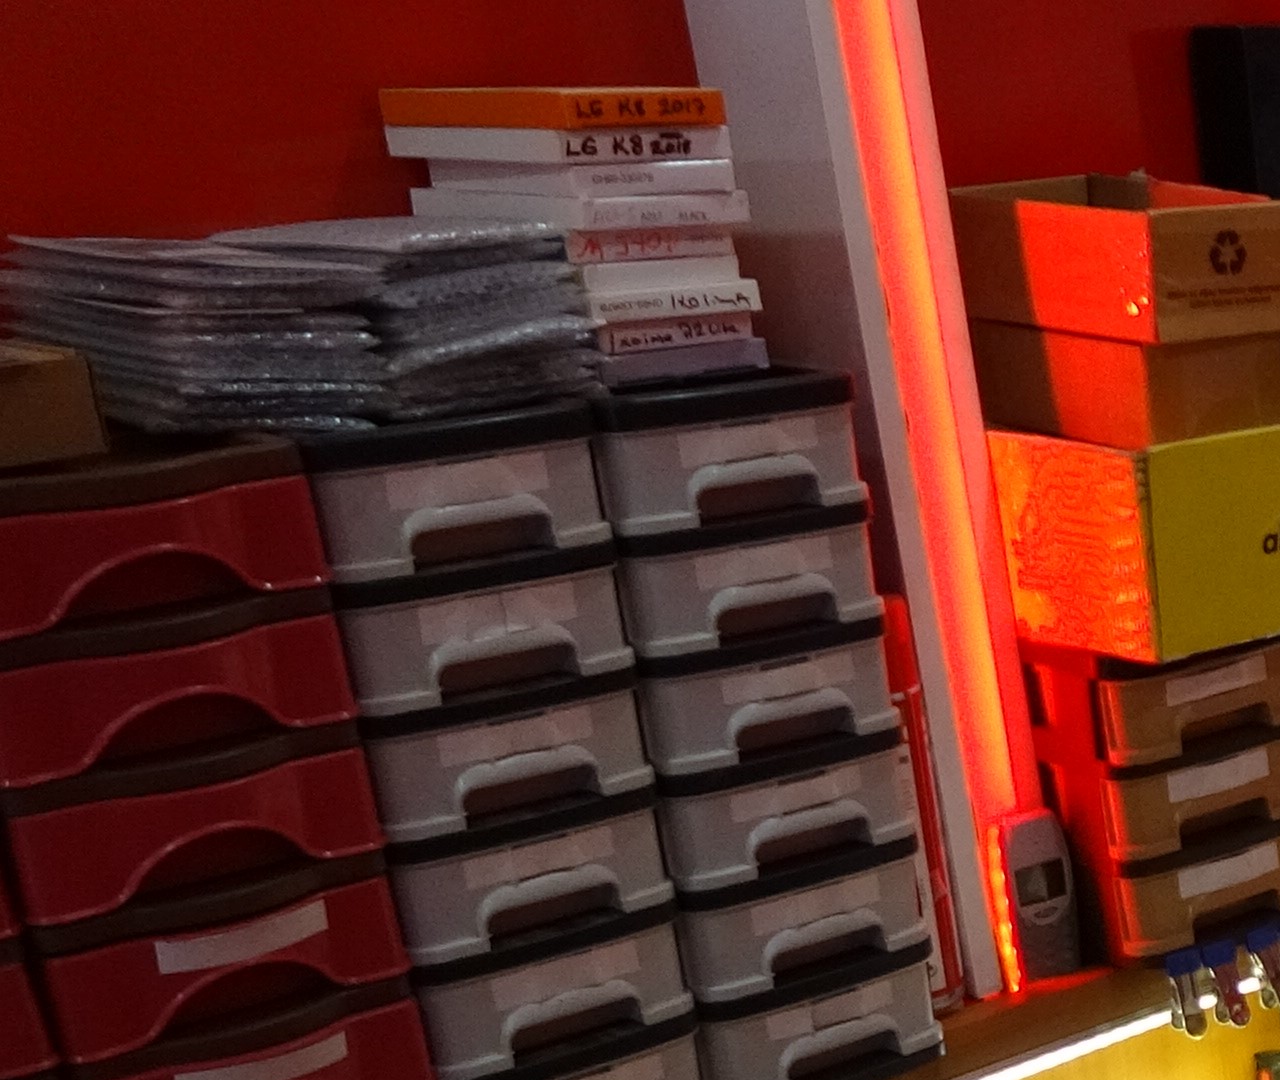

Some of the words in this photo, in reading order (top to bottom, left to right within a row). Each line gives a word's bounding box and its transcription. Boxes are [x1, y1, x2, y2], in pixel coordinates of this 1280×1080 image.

[576, 101, 603, 117] LG
[566, 137, 598, 156] LG
[613, 134, 643, 155] K8
